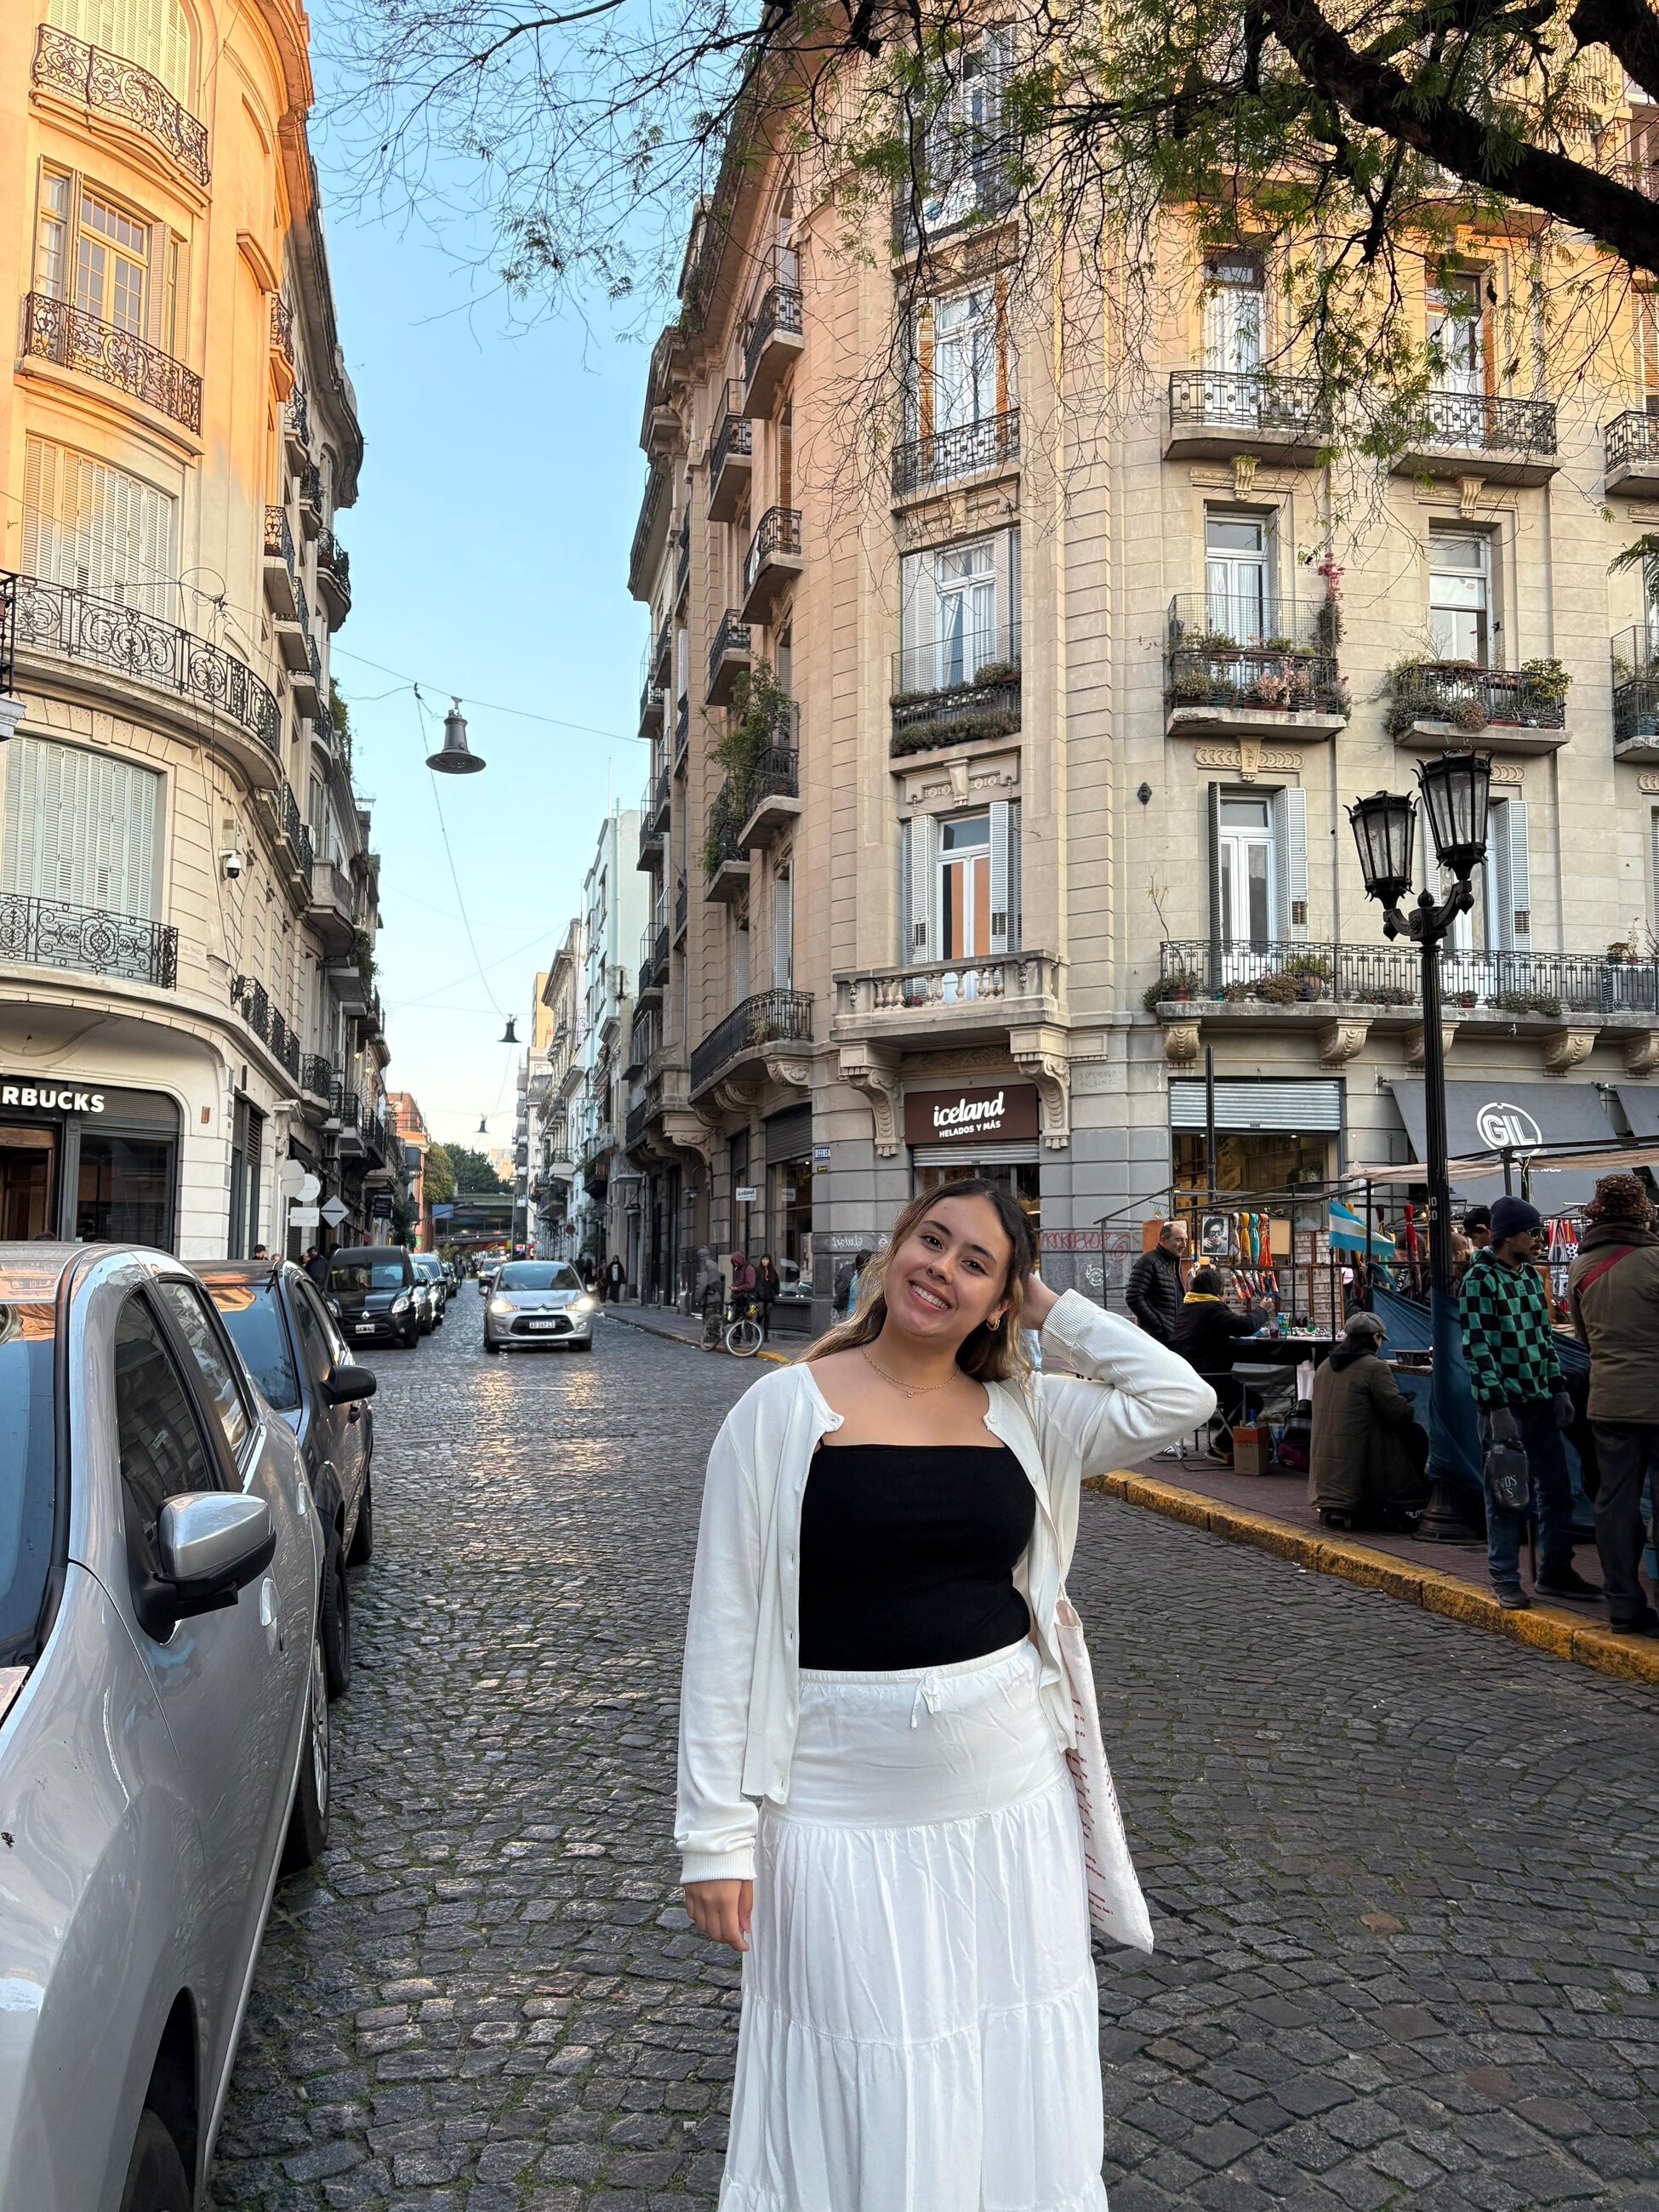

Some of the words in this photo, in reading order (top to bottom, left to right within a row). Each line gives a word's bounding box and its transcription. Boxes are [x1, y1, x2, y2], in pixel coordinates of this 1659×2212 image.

[2, 1086, 105, 1113] RBUCKS
[933, 1091, 1005, 1126] iceland
[939, 1125, 974, 1137] HELADOS
[983, 1120, 1001, 1131] MÁS
[1482, 1115, 1537, 1146] GIL
